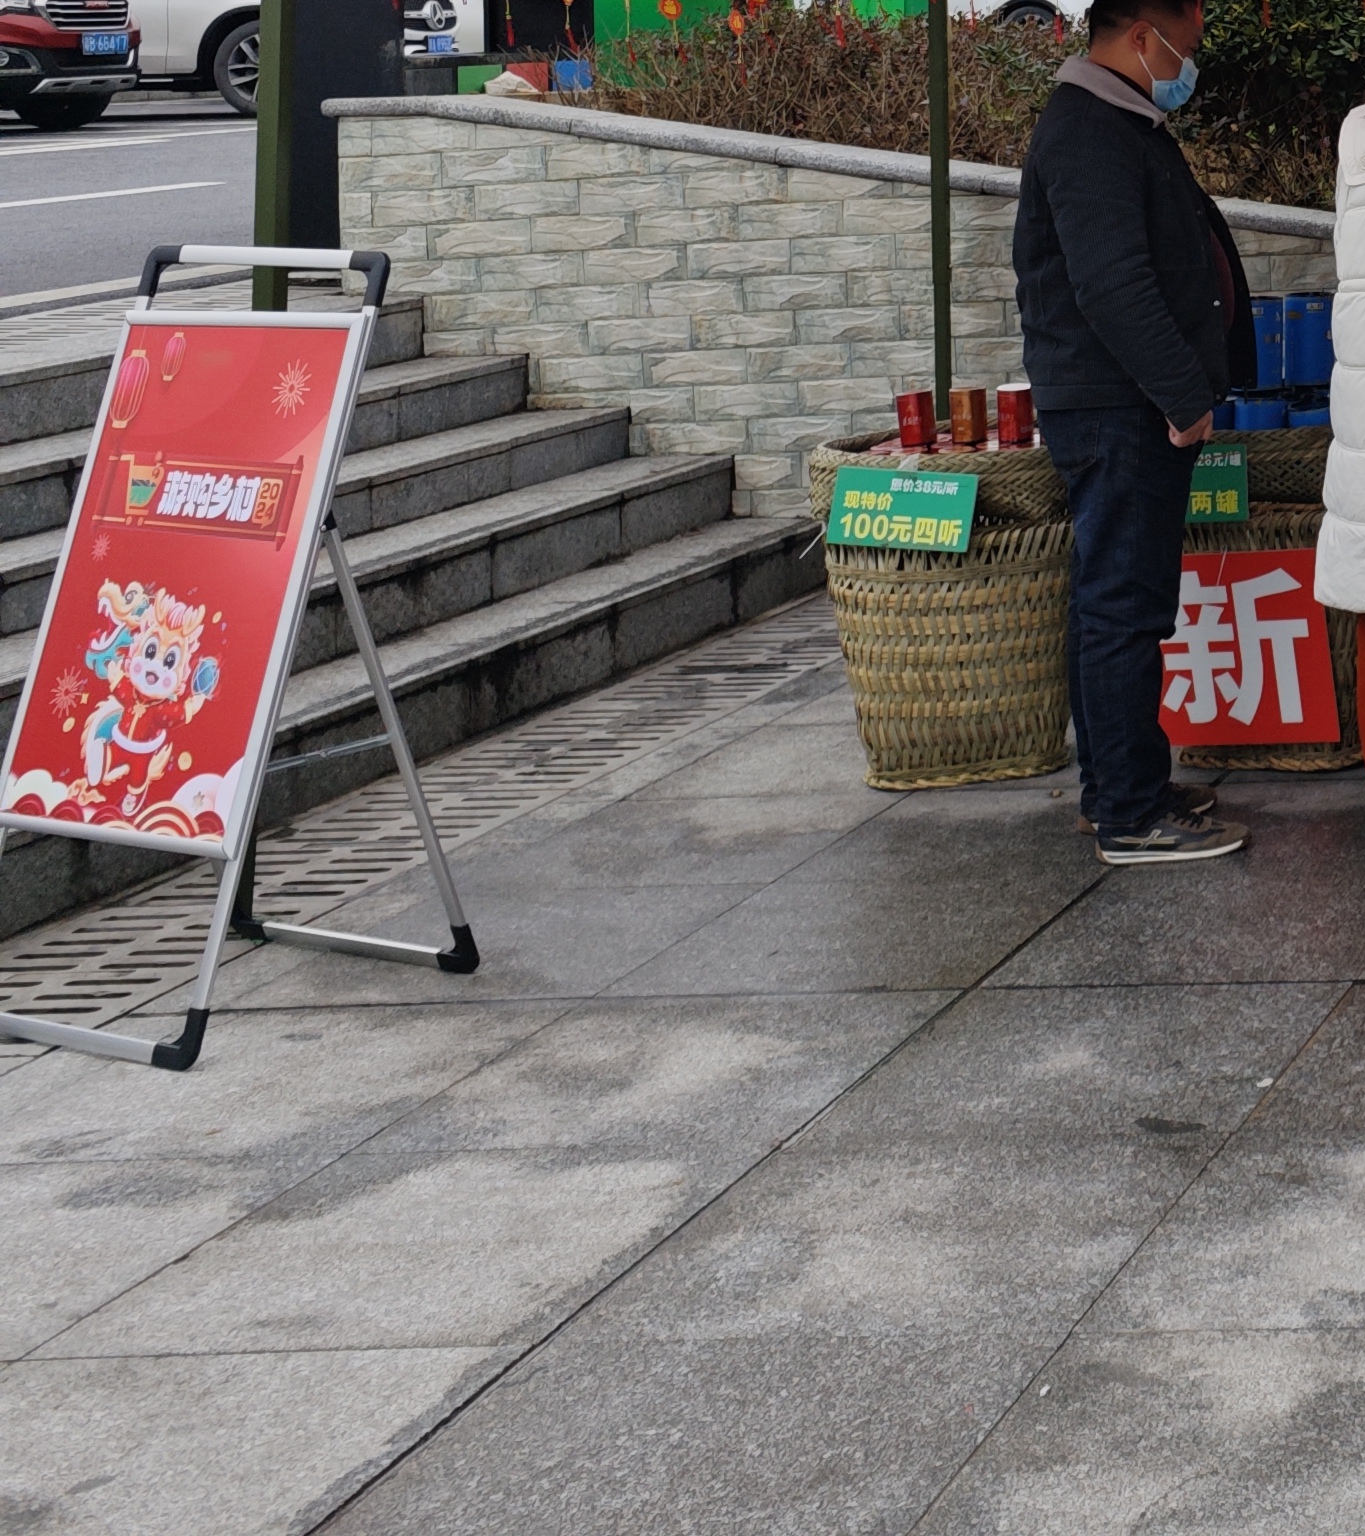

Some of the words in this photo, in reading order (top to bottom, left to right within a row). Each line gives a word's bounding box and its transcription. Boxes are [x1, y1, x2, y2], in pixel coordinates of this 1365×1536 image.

[156, 469, 261, 522] 游购乡村
[259, 481, 280, 500] 20
[843, 489, 895, 512] 现特价
[1190, 489, 1240, 516] 两罐
[254, 501, 275, 520] 24
[838, 511, 963, 548] 100元四听
[1161, 567, 1311, 726] 新
